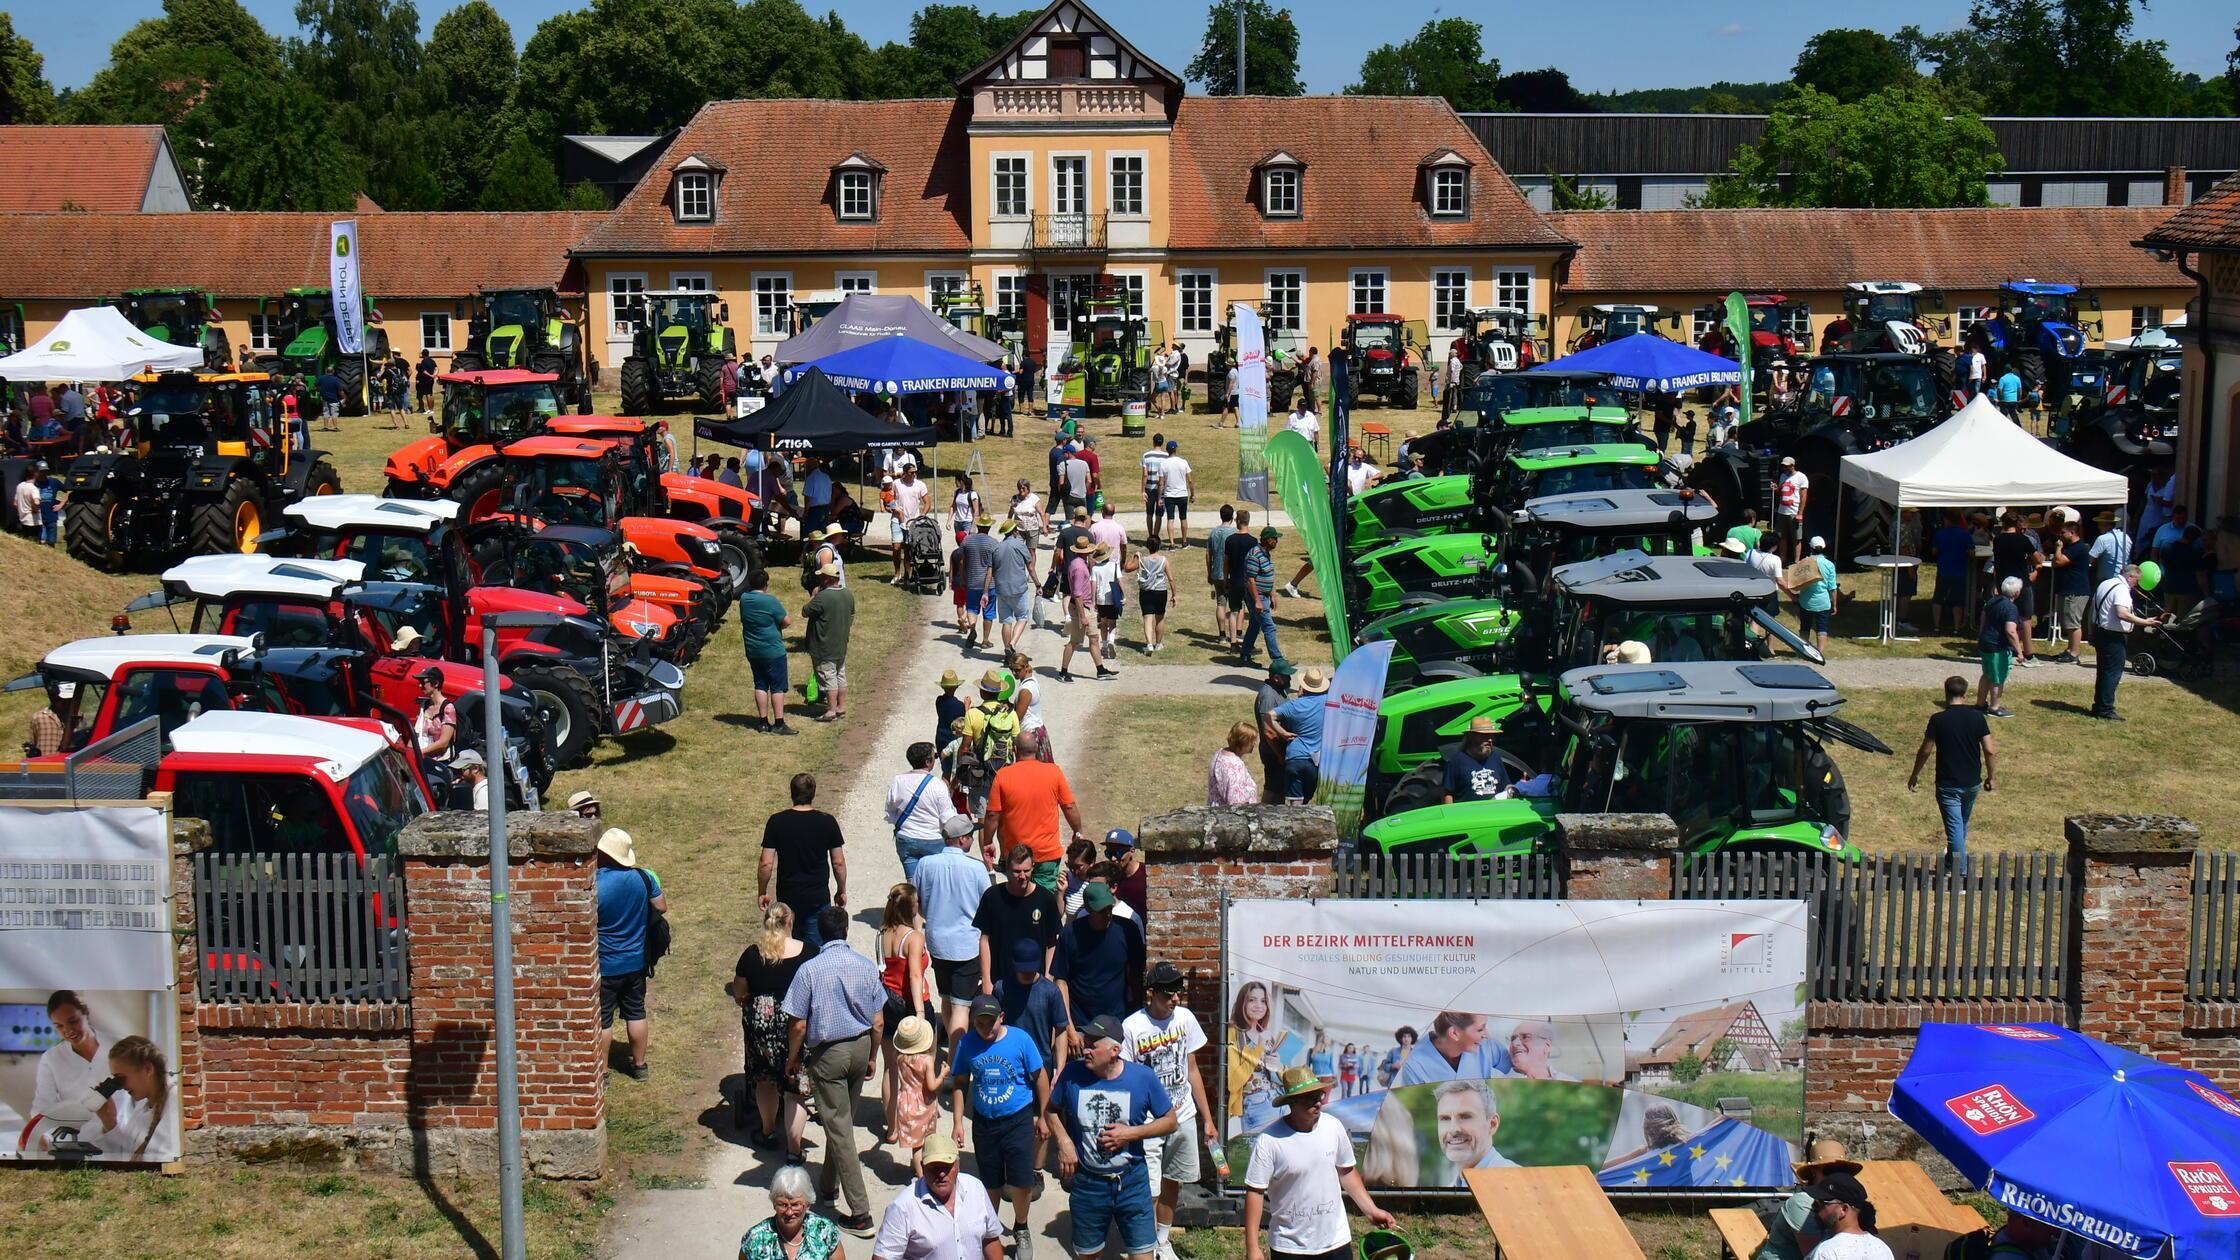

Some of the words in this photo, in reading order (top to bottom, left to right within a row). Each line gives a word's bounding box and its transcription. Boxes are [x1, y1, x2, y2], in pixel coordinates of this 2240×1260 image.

[839, 323, 864, 332] CLAAS
[833, 375, 870, 390] BRUNNEN
[902, 380, 949, 391] FRANKEN
[950, 377, 997, 388] BRUNNEN
[1610, 375, 1640, 389] NNEN
[1672, 372, 1709, 388] FRANKEN
[1865, 407, 1874, 416] 50
[775, 439, 813, 449] STIGA
[1264, 935, 1291, 948] DER
[1296, 935, 1350, 948] BEZIRK
[1353, 935, 1475, 948] MITTELFRANKEN
[1298, 953, 1340, 963] SOZIALES
[1342, 953, 1383, 962] BILDUNG
[1384, 953, 1441, 963] GESUNDHEIT
[1443, 953, 1476, 962] KULTUR
[1348, 966, 1378, 975] NATUR
[1380, 966, 1400, 975] UND
[1401, 966, 1439, 975] UMWELT
[1440, 966, 1476, 975] EUROPA
[1136, 1025, 1187, 1055] BERLIN
[1971, 1095, 2007, 1124] SPRUDEL
[1981, 1089, 2022, 1121] RHÖN
[2176, 1167, 2224, 1184] RHÖN
[2188, 1184, 2233, 1194] SPRUDEL
